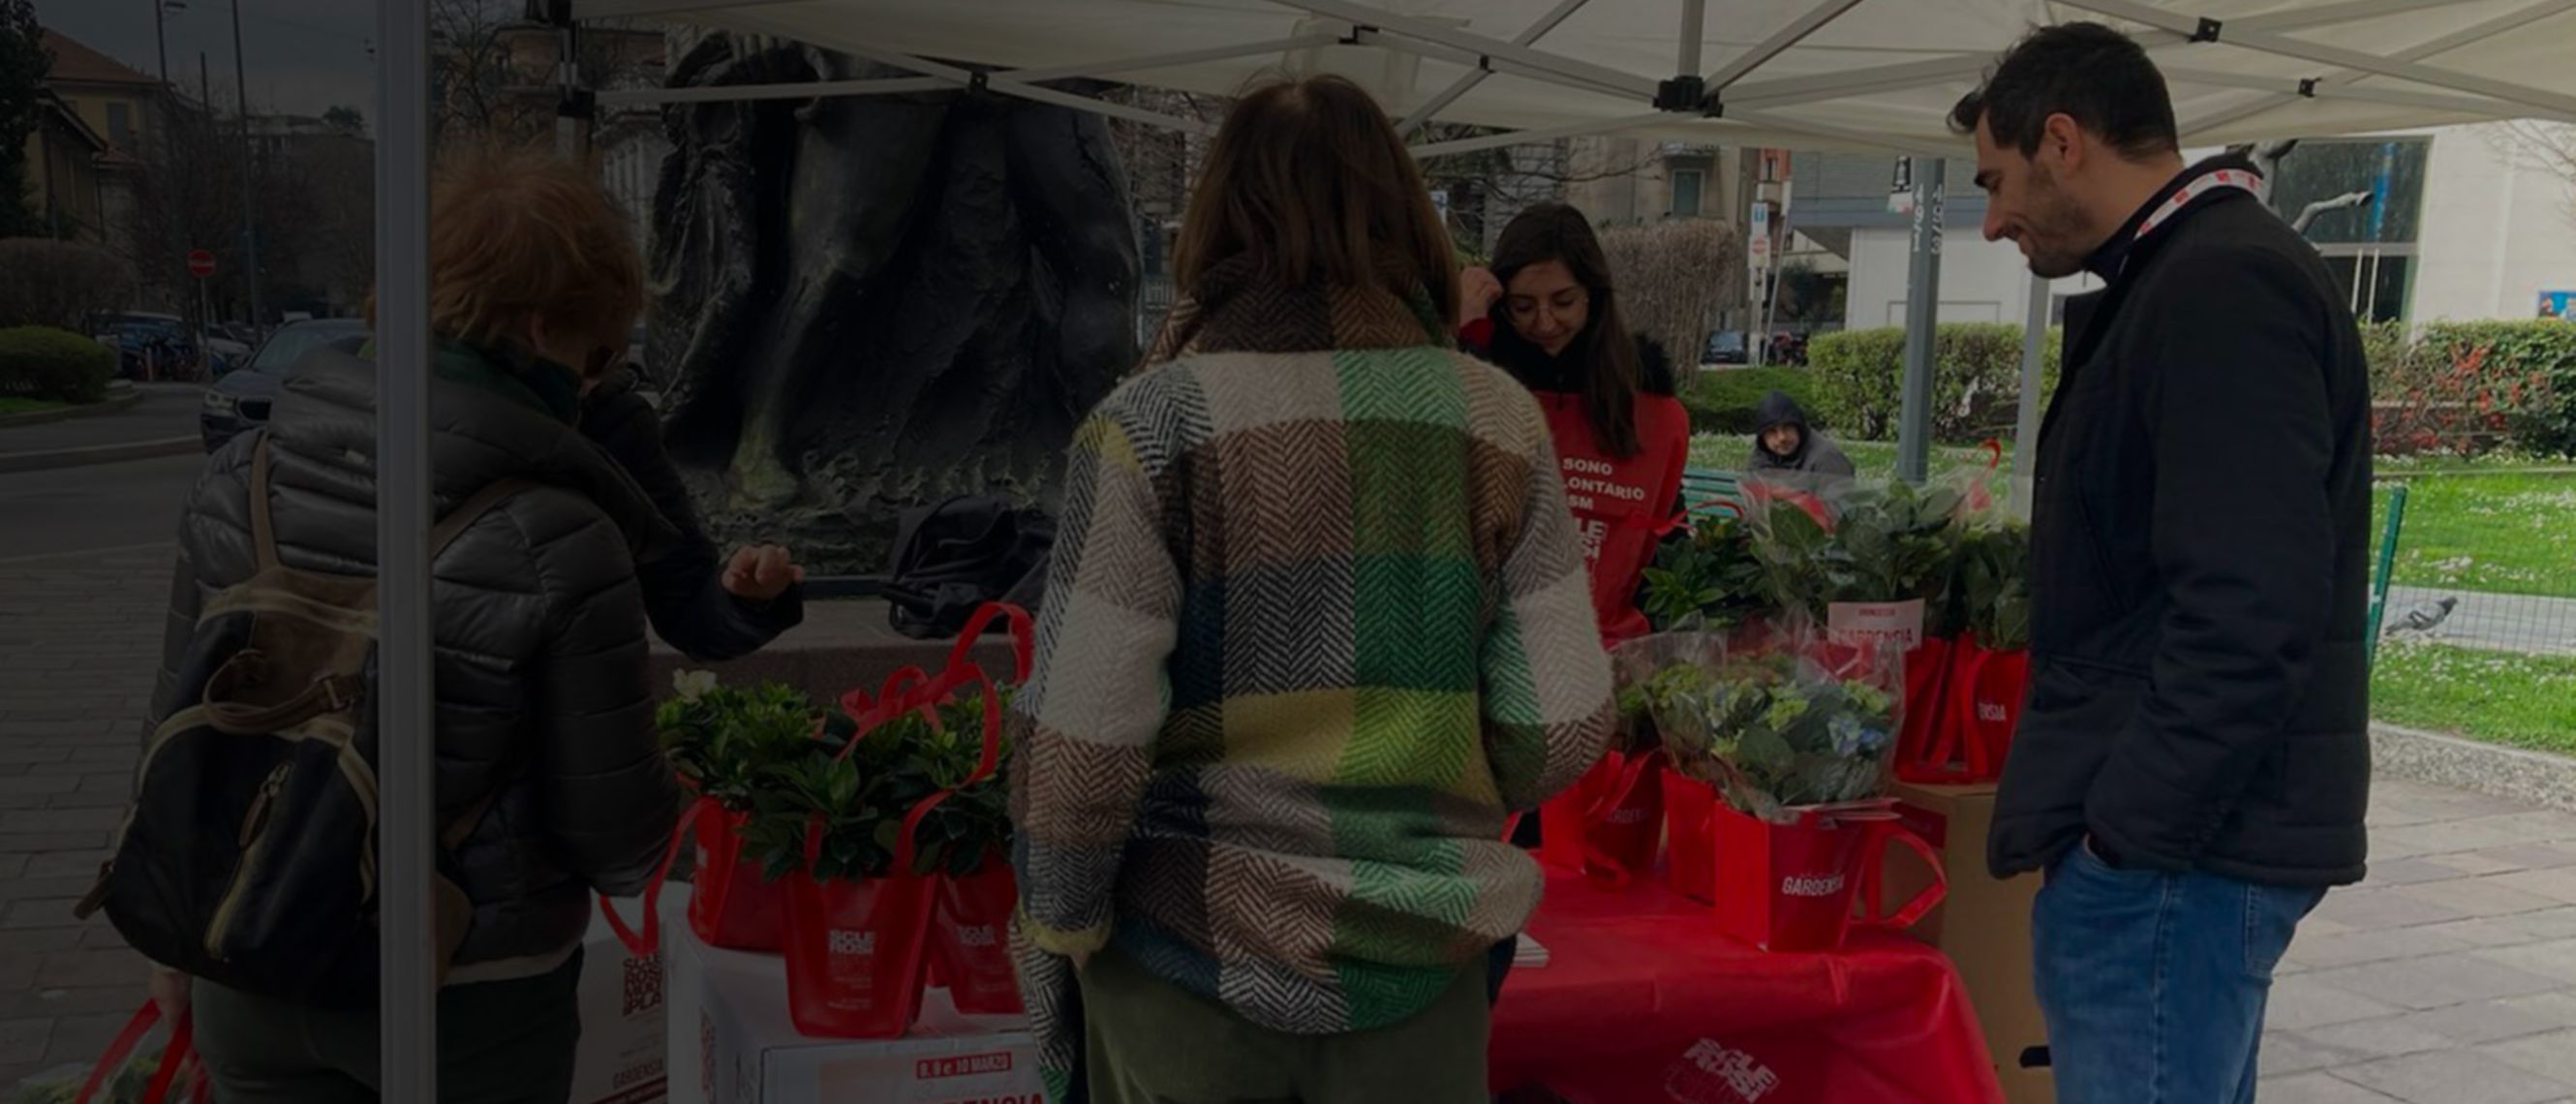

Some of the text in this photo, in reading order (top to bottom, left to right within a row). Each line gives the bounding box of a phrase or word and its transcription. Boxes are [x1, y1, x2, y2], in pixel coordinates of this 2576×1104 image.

[1562, 457, 1613, 475] SONO
[1566, 476, 1645, 501] ONTARIO
[1568, 494, 1594, 510] SM
